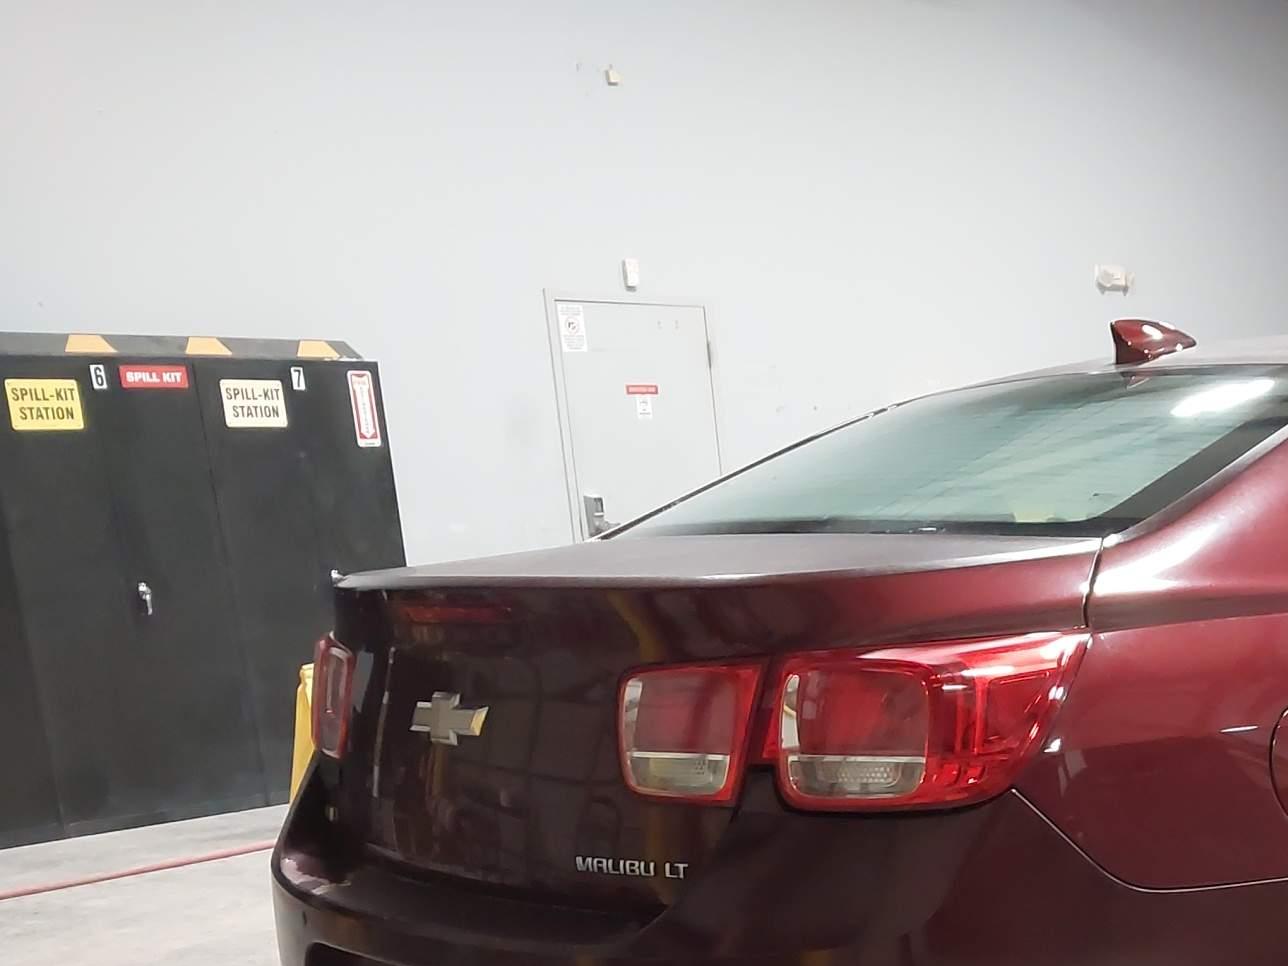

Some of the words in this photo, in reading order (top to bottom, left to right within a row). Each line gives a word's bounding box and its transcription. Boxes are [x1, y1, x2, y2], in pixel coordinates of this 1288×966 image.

[93, 366, 104, 387] 6
[126, 371, 160, 383] SPILL
[163, 372, 183, 383] KIT
[293, 369, 301, 388] 7
[11, 387, 75, 401] SPILL-KIT
[225, 387, 280, 401] SPILL-KIT
[19, 406, 75, 420] STATION
[232, 405, 280, 418] STATION
[575, 856, 656, 877] MALIBU
[664, 861, 689, 880] LT
